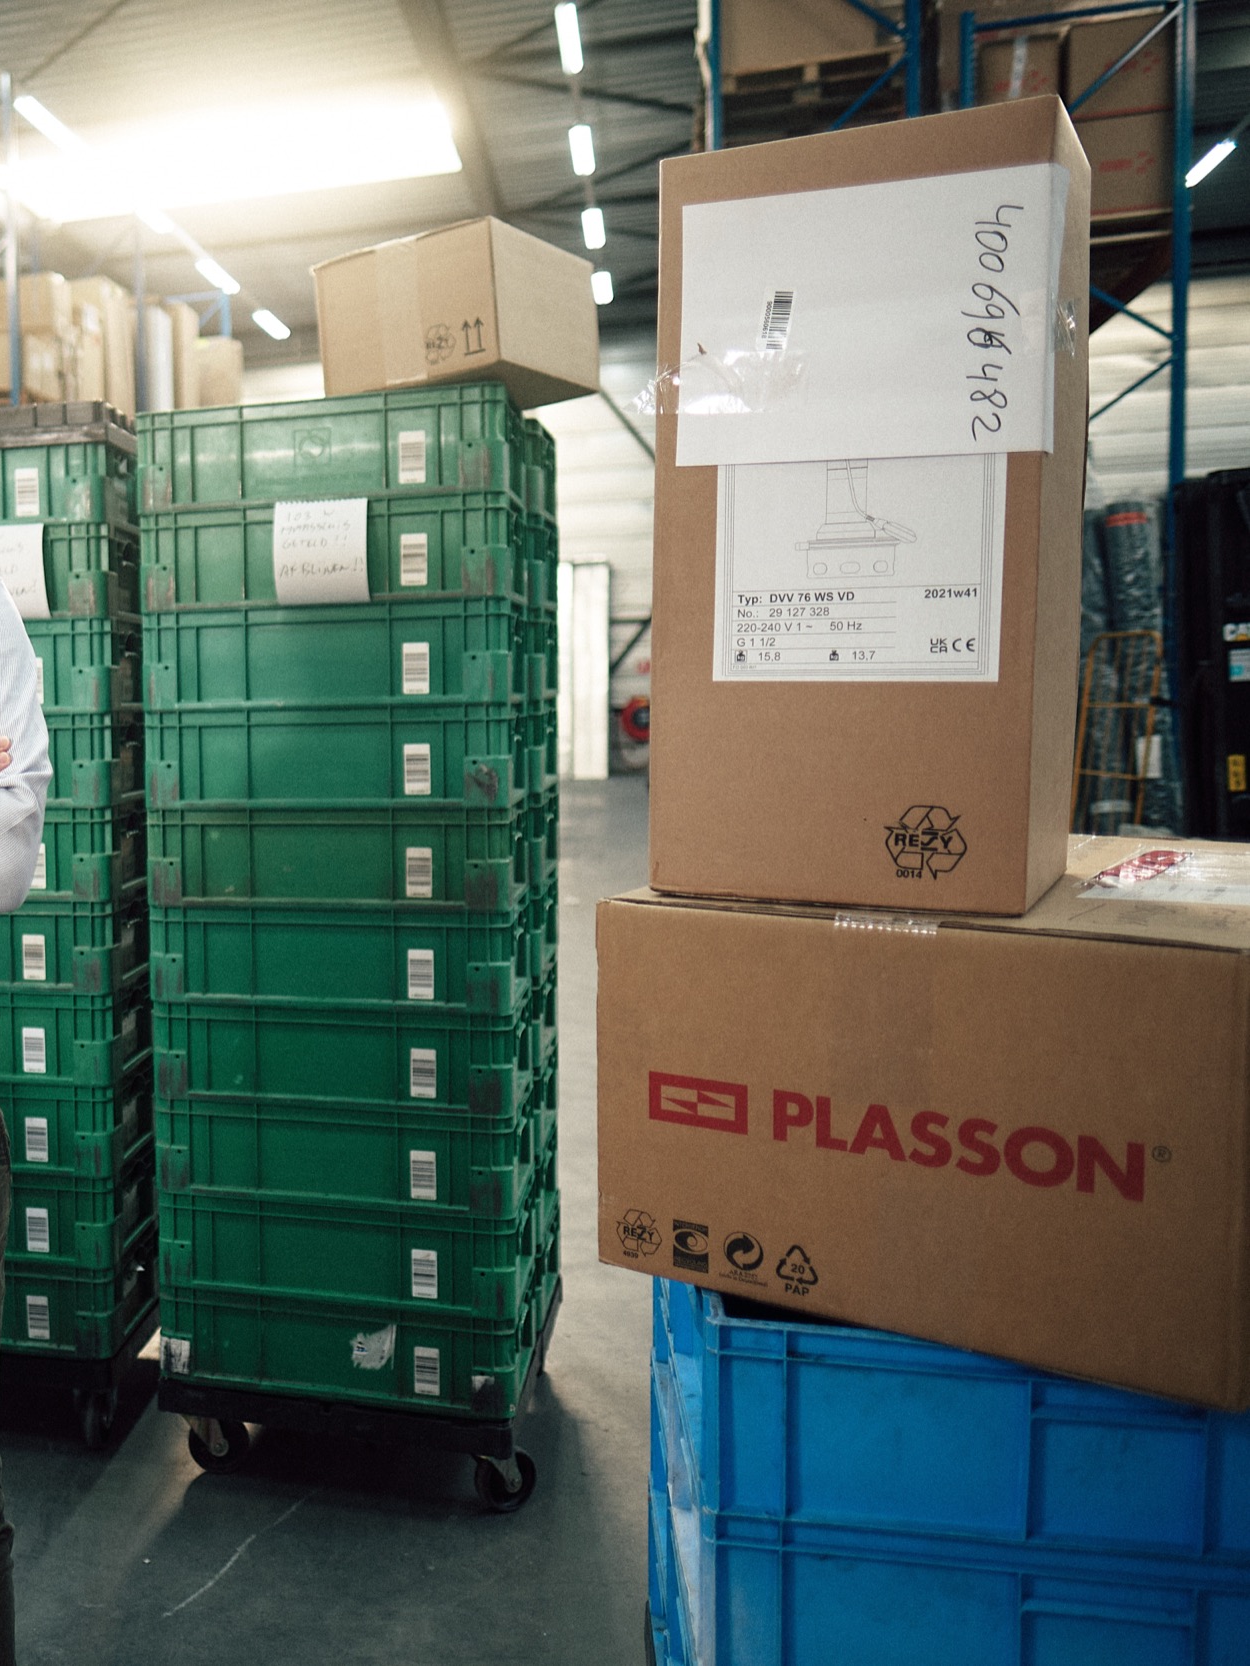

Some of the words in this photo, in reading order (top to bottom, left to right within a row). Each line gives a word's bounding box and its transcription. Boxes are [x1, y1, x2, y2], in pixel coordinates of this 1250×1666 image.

[737, 594, 763, 606] Typ:
[769, 592, 794, 604] DVV
[798, 592, 811, 602] 76
[813, 591, 834, 602] WS
[837, 591, 855, 601] VD
[924, 588, 978, 599] 2021w41
[737, 608, 759, 618] No.:
[769, 607, 783, 617] 29
[787, 607, 806, 617] 127
[809, 606, 830, 616] 328
[737, 622, 781, 633] 220-240
[784, 622, 794, 632] V
[796, 622, 802, 632] 1
[829, 621, 844, 631] 50
[847, 621, 862, 631] Hz
[736, 637, 746, 647] G
[760, 637, 775, 647] 1/2
[758, 651, 781, 662] 15,8
[852, 650, 876, 661] 13,7
[894, 830, 953, 852] REZY
[896, 869, 922, 879] 0014
[772, 1089, 1145, 1203] PLASSON
[623, 1225, 656, 1243] REZY
[791, 1263, 805, 1275] 20
[784, 1283, 810, 1297] PAP
